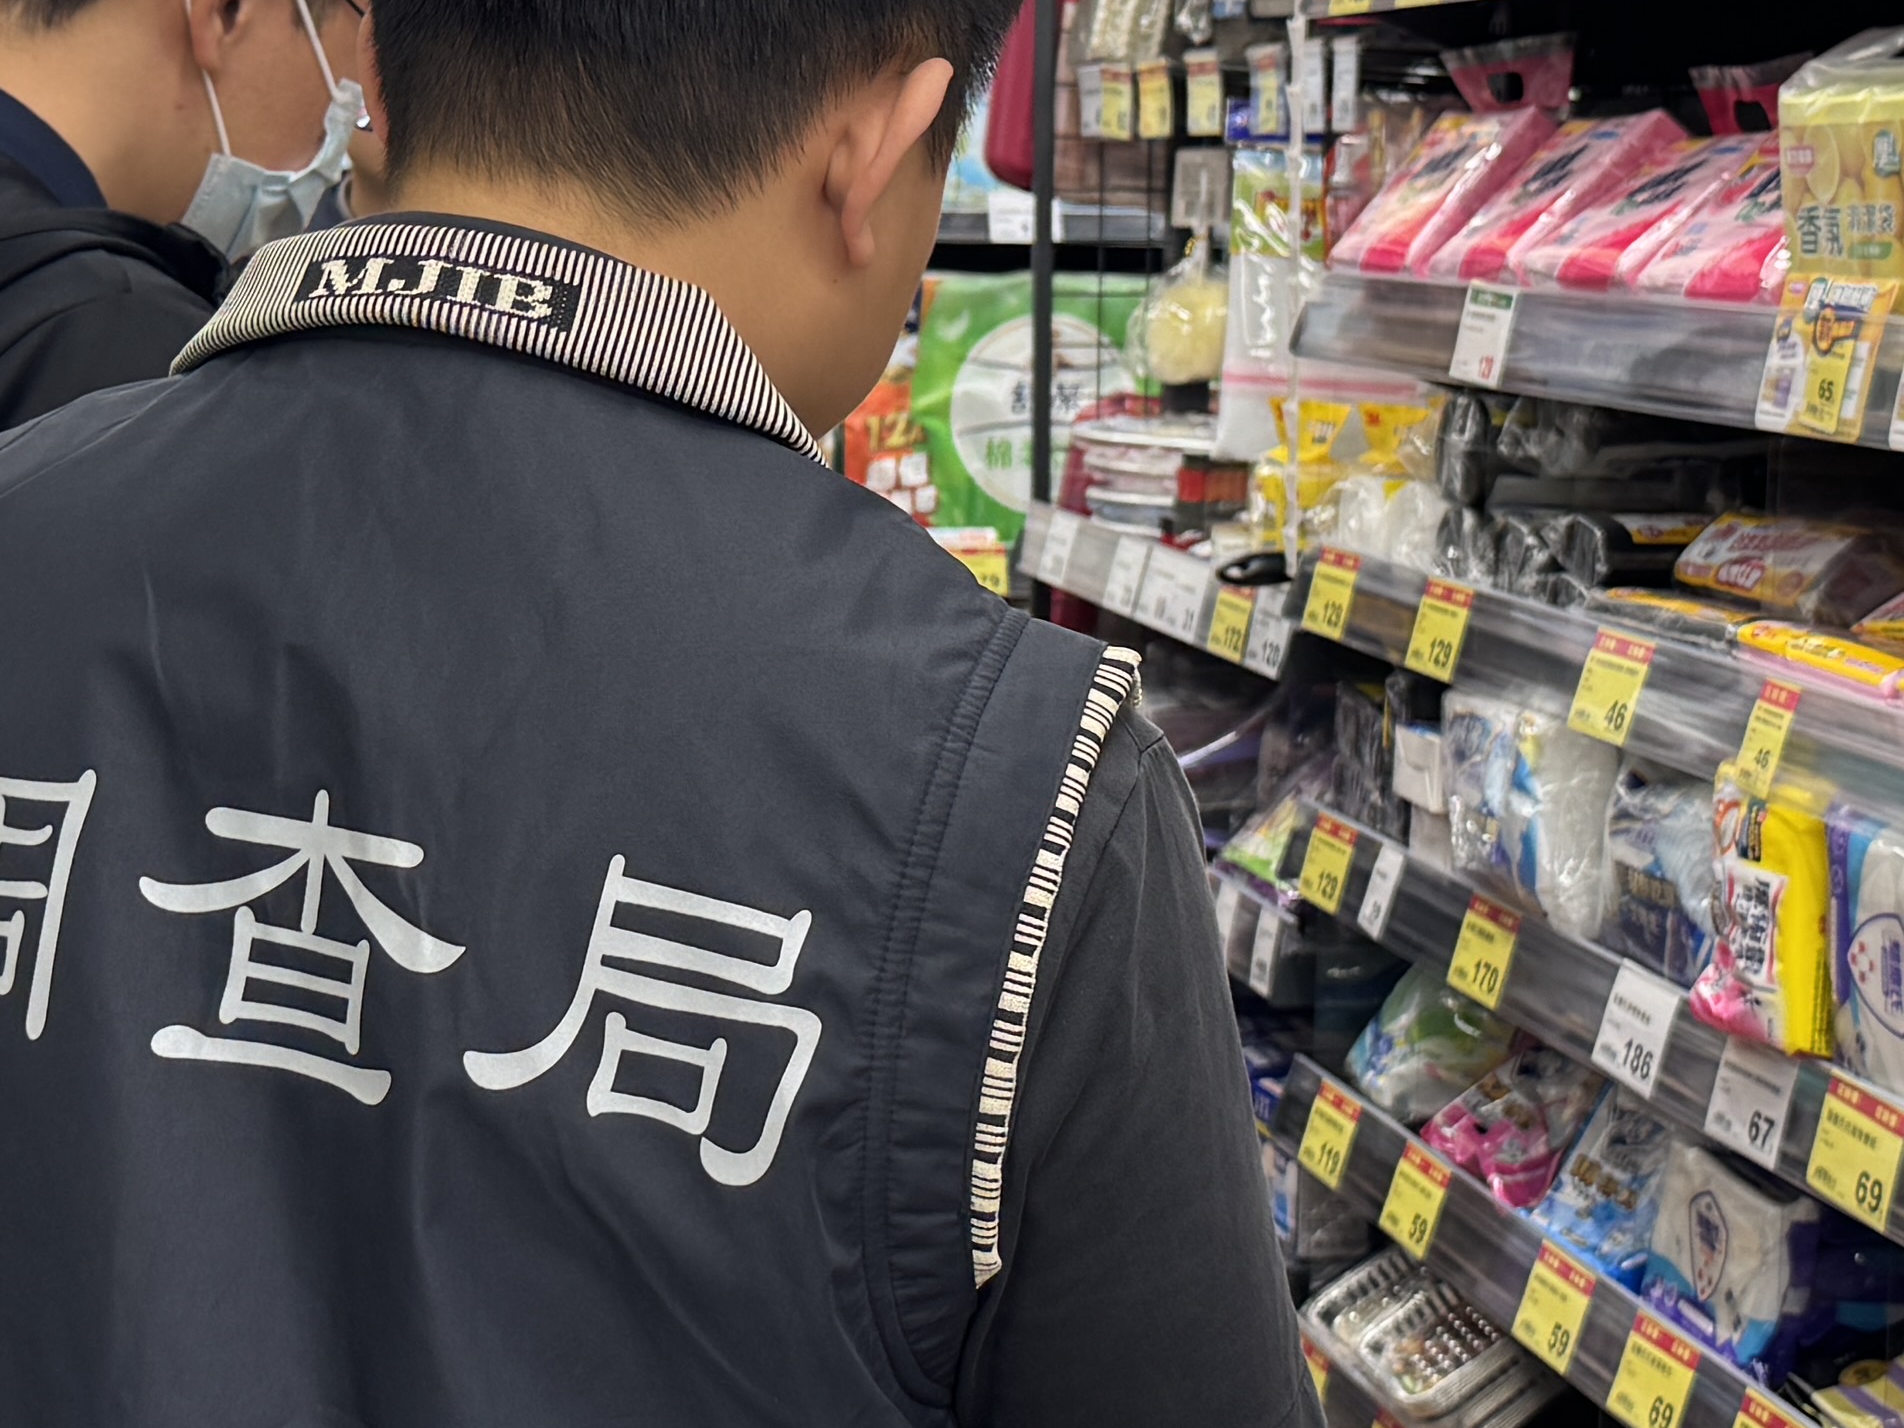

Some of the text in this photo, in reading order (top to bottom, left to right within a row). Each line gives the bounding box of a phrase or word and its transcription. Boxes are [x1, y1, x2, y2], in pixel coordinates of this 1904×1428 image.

[308, 259, 553, 324] MJIB
[1748, 1109, 1776, 1149] 67
[1855, 1170, 1883, 1214] 69
